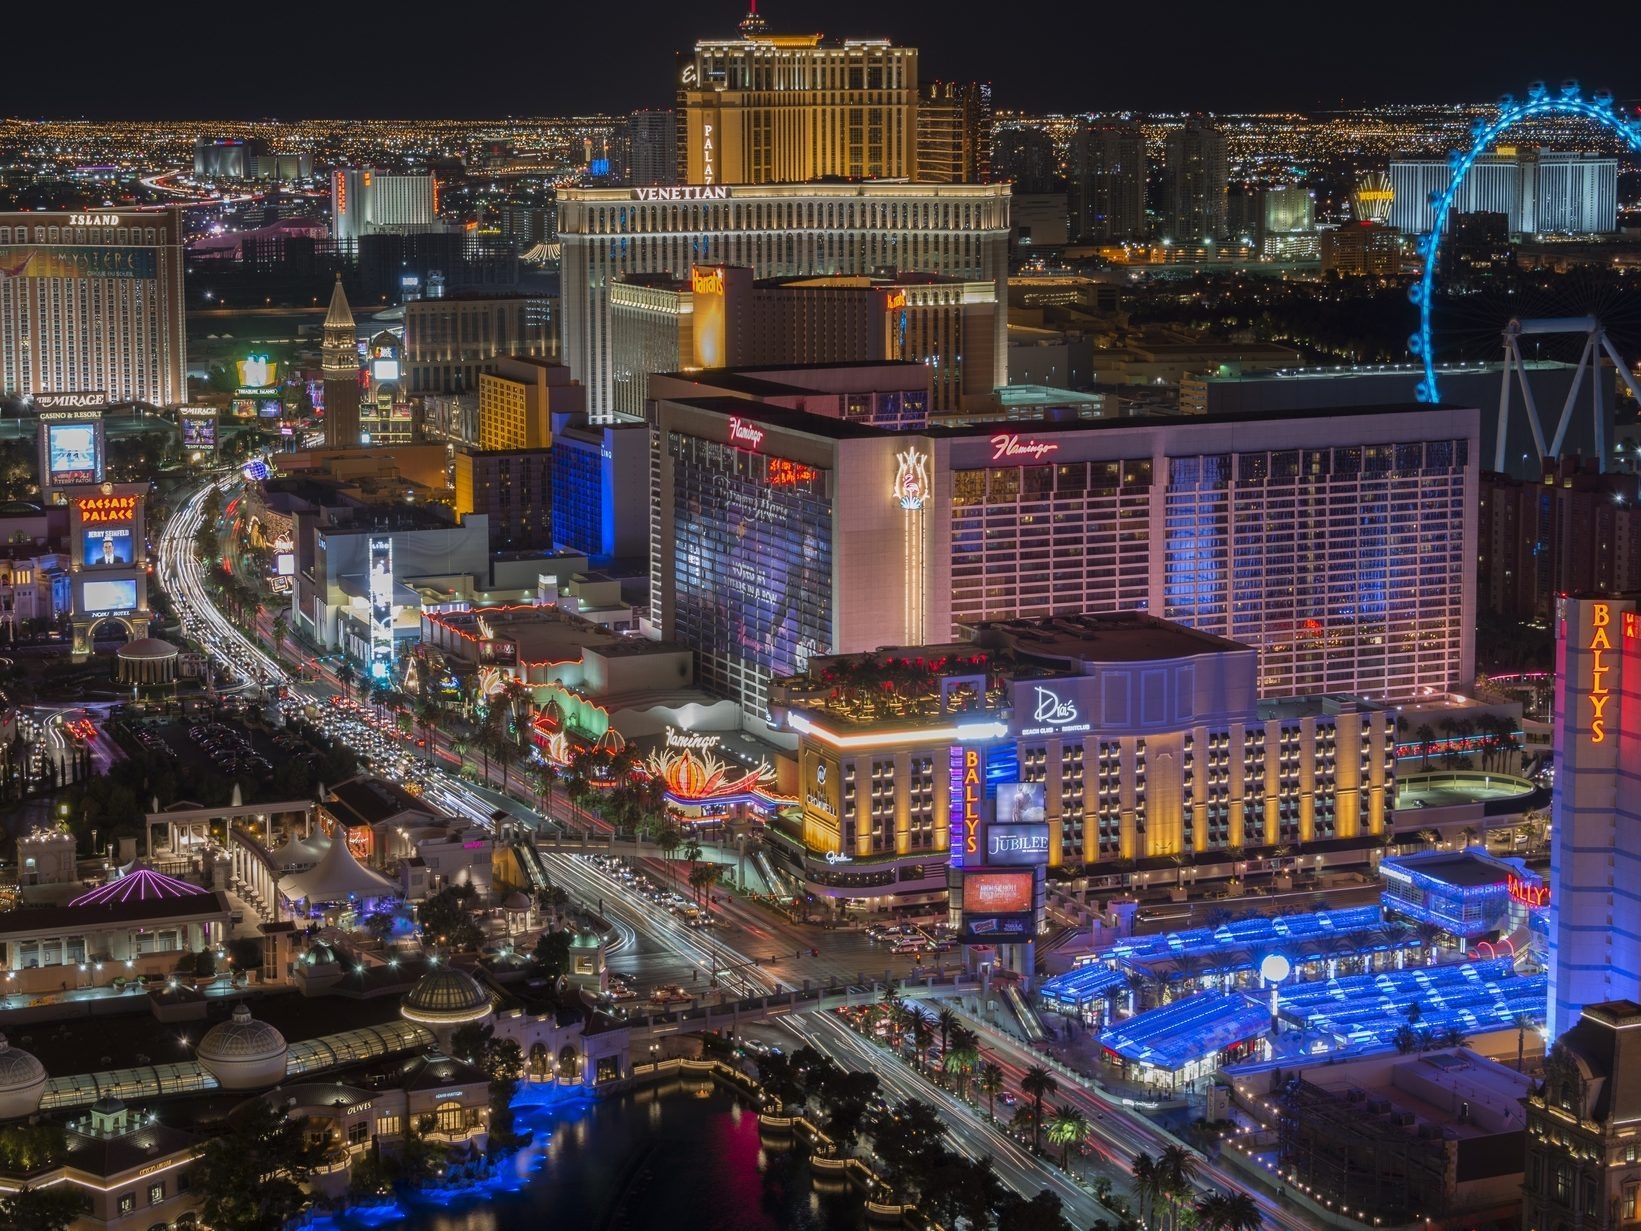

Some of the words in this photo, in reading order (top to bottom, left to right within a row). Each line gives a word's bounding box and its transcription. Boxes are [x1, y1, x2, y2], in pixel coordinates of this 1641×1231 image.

[636, 186, 727, 200] VENETIAN
[1359, 191, 1394, 200] WESTGATE
[70, 214, 119, 226] ISLAND
[42, 394, 104, 408] MIRAGE
[74, 410, 102, 418] RESORT
[183, 407, 217, 415] MIRAGE
[729, 416, 764, 448] Flamingo
[990, 434, 1058, 460] Flamingo
[79, 497, 135, 510] CAESARS
[82, 509, 133, 522] PALACE
[88, 530, 105, 538] JERRY
[105, 529, 129, 538] SEINFELD
[1589, 604, 1611, 743] BALLYS
[1034, 685, 1077, 724] Drai's
[665, 725, 720, 755] Flamingo
[807, 794, 837, 817] CROMWELL
[964, 751, 980, 853] BALLYS
[988, 836, 1048, 855] JUBILEE
[347, 1101, 372, 1115] OLIVES
